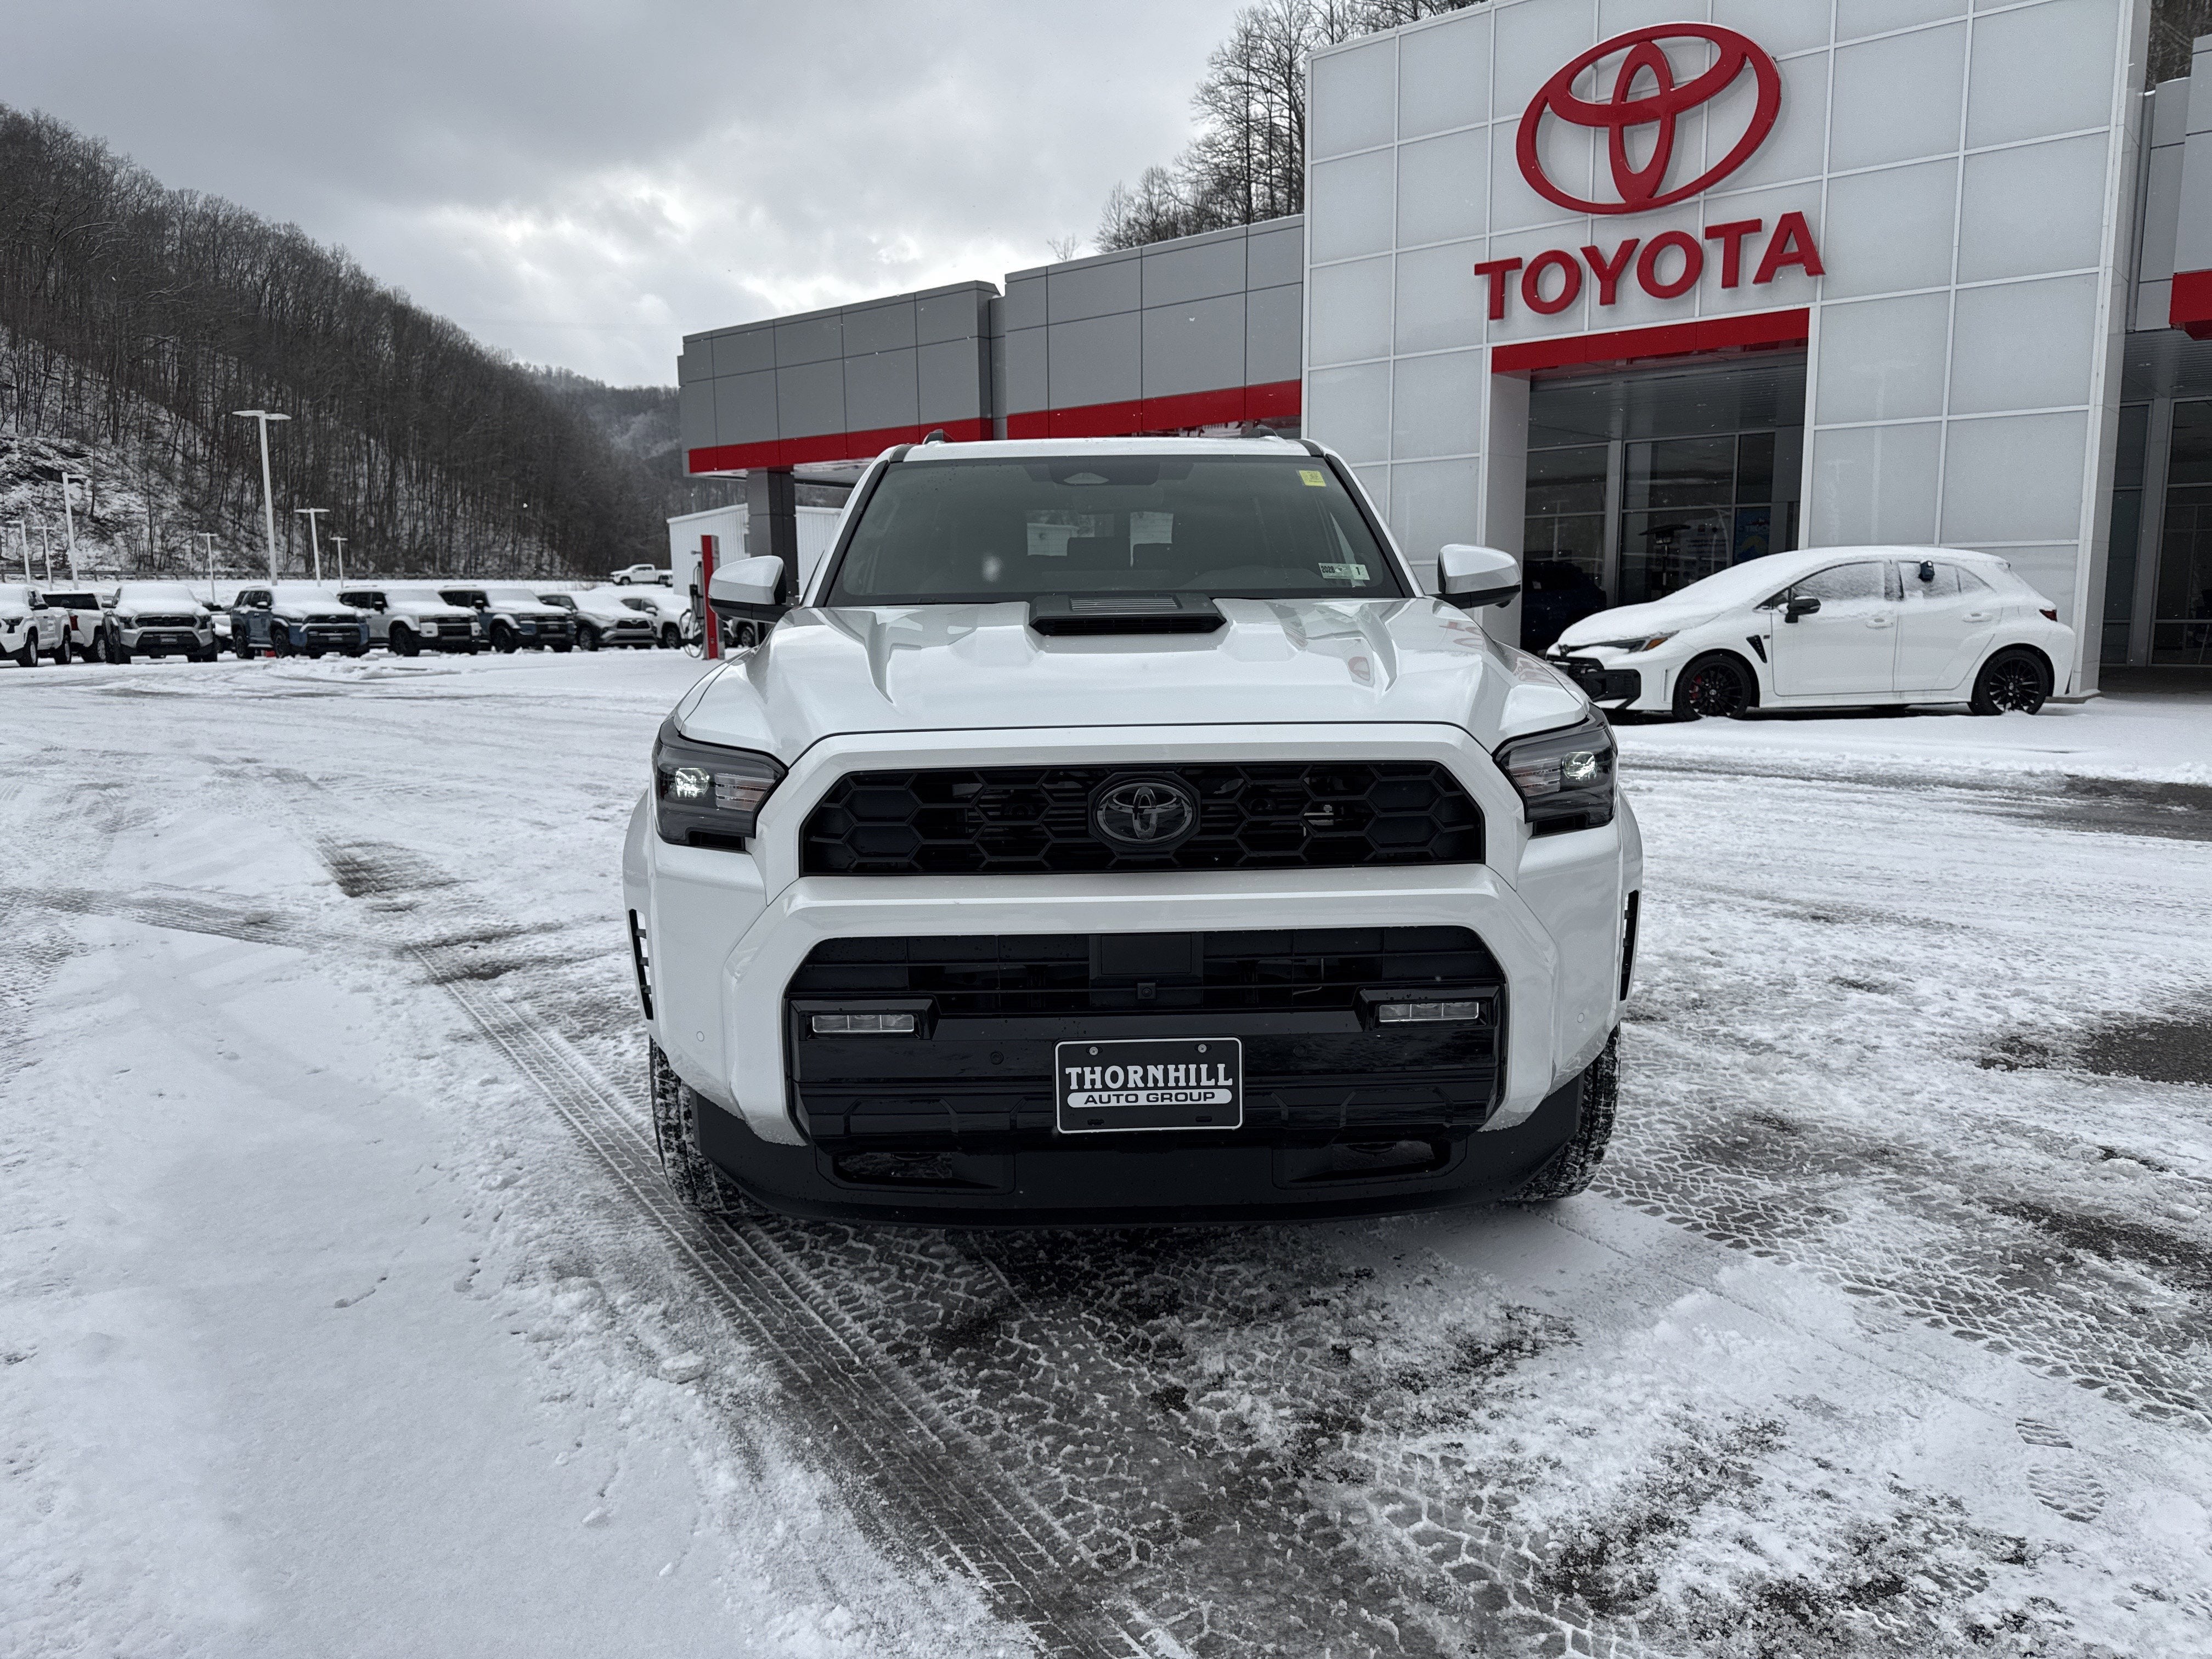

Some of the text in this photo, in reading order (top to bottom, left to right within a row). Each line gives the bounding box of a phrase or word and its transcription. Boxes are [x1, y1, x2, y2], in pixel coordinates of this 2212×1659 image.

[1474, 211, 1826, 320] TOYOTA
[1355, 566, 1361, 575] 1
[1065, 1063, 1233, 1090] THORNHILL
[1084, 1092, 1215, 1105] AUTO GROUP
